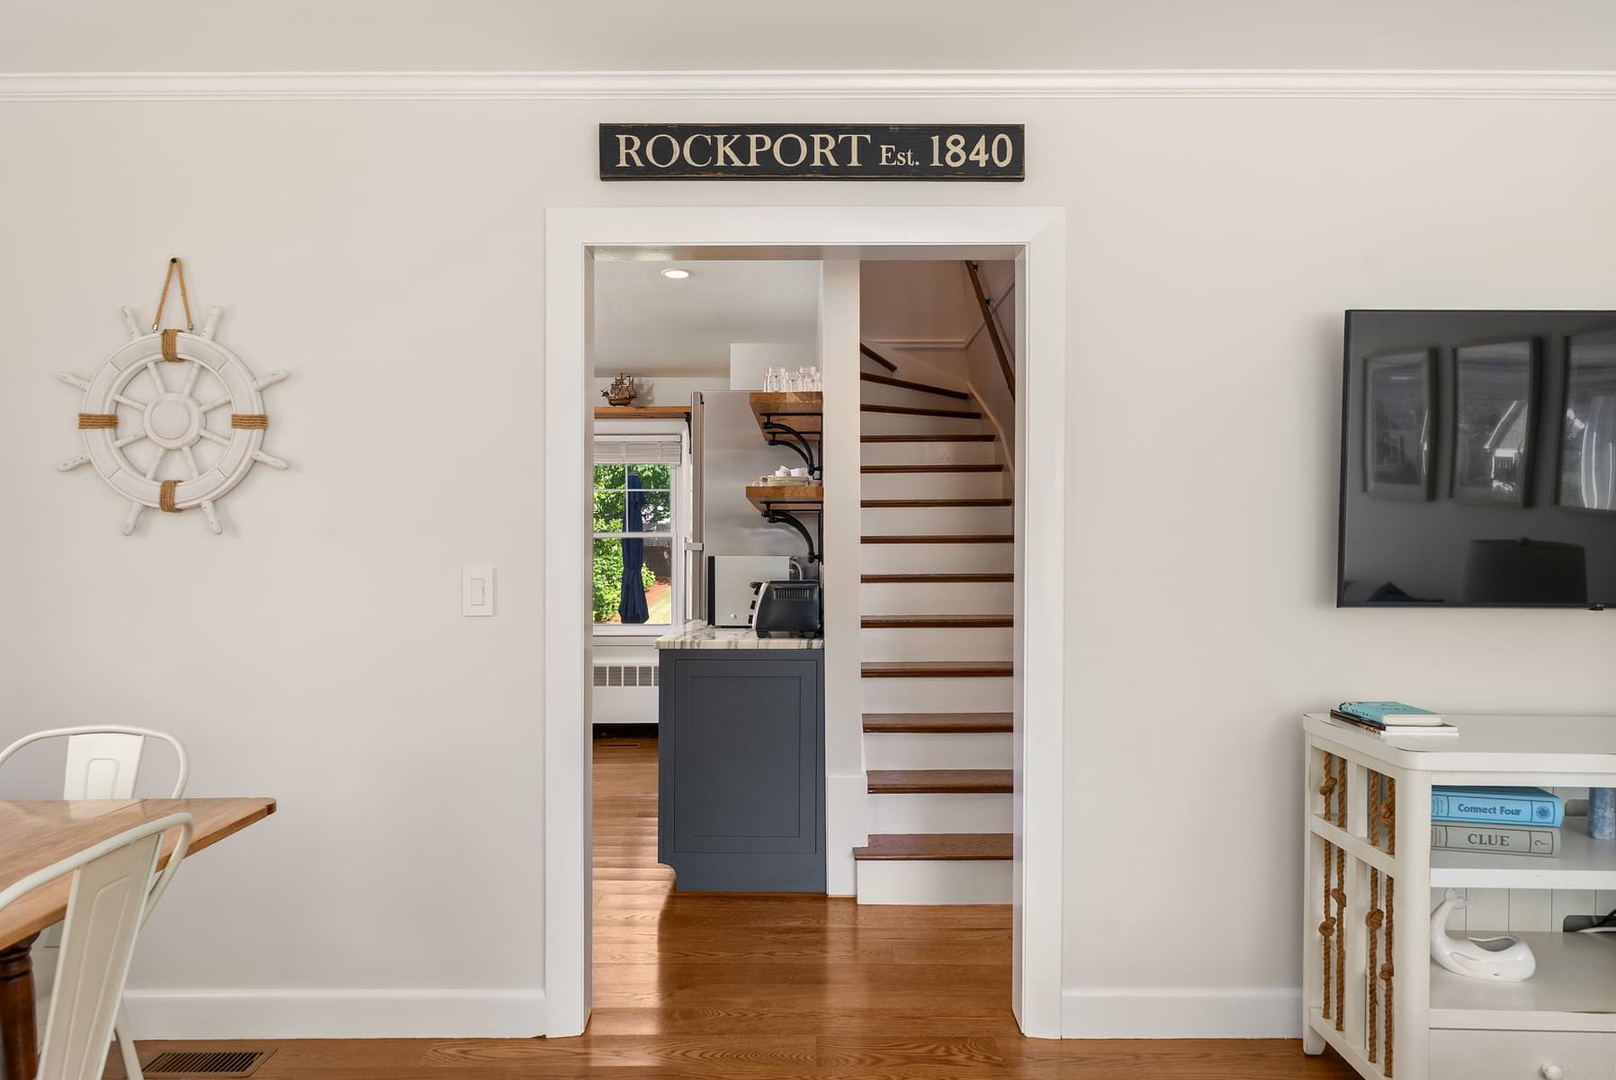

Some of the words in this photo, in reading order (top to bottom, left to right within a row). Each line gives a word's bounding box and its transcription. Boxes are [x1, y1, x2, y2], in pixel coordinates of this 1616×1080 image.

[615, 134, 871, 168] ROCKPORT
[880, 145, 919, 167] Est.
[929, 133, 1013, 168] 1840
[1457, 803, 1497, 815] Connect
[1500, 806, 1522, 816] Four
[1467, 834, 1510, 847] CLUE
